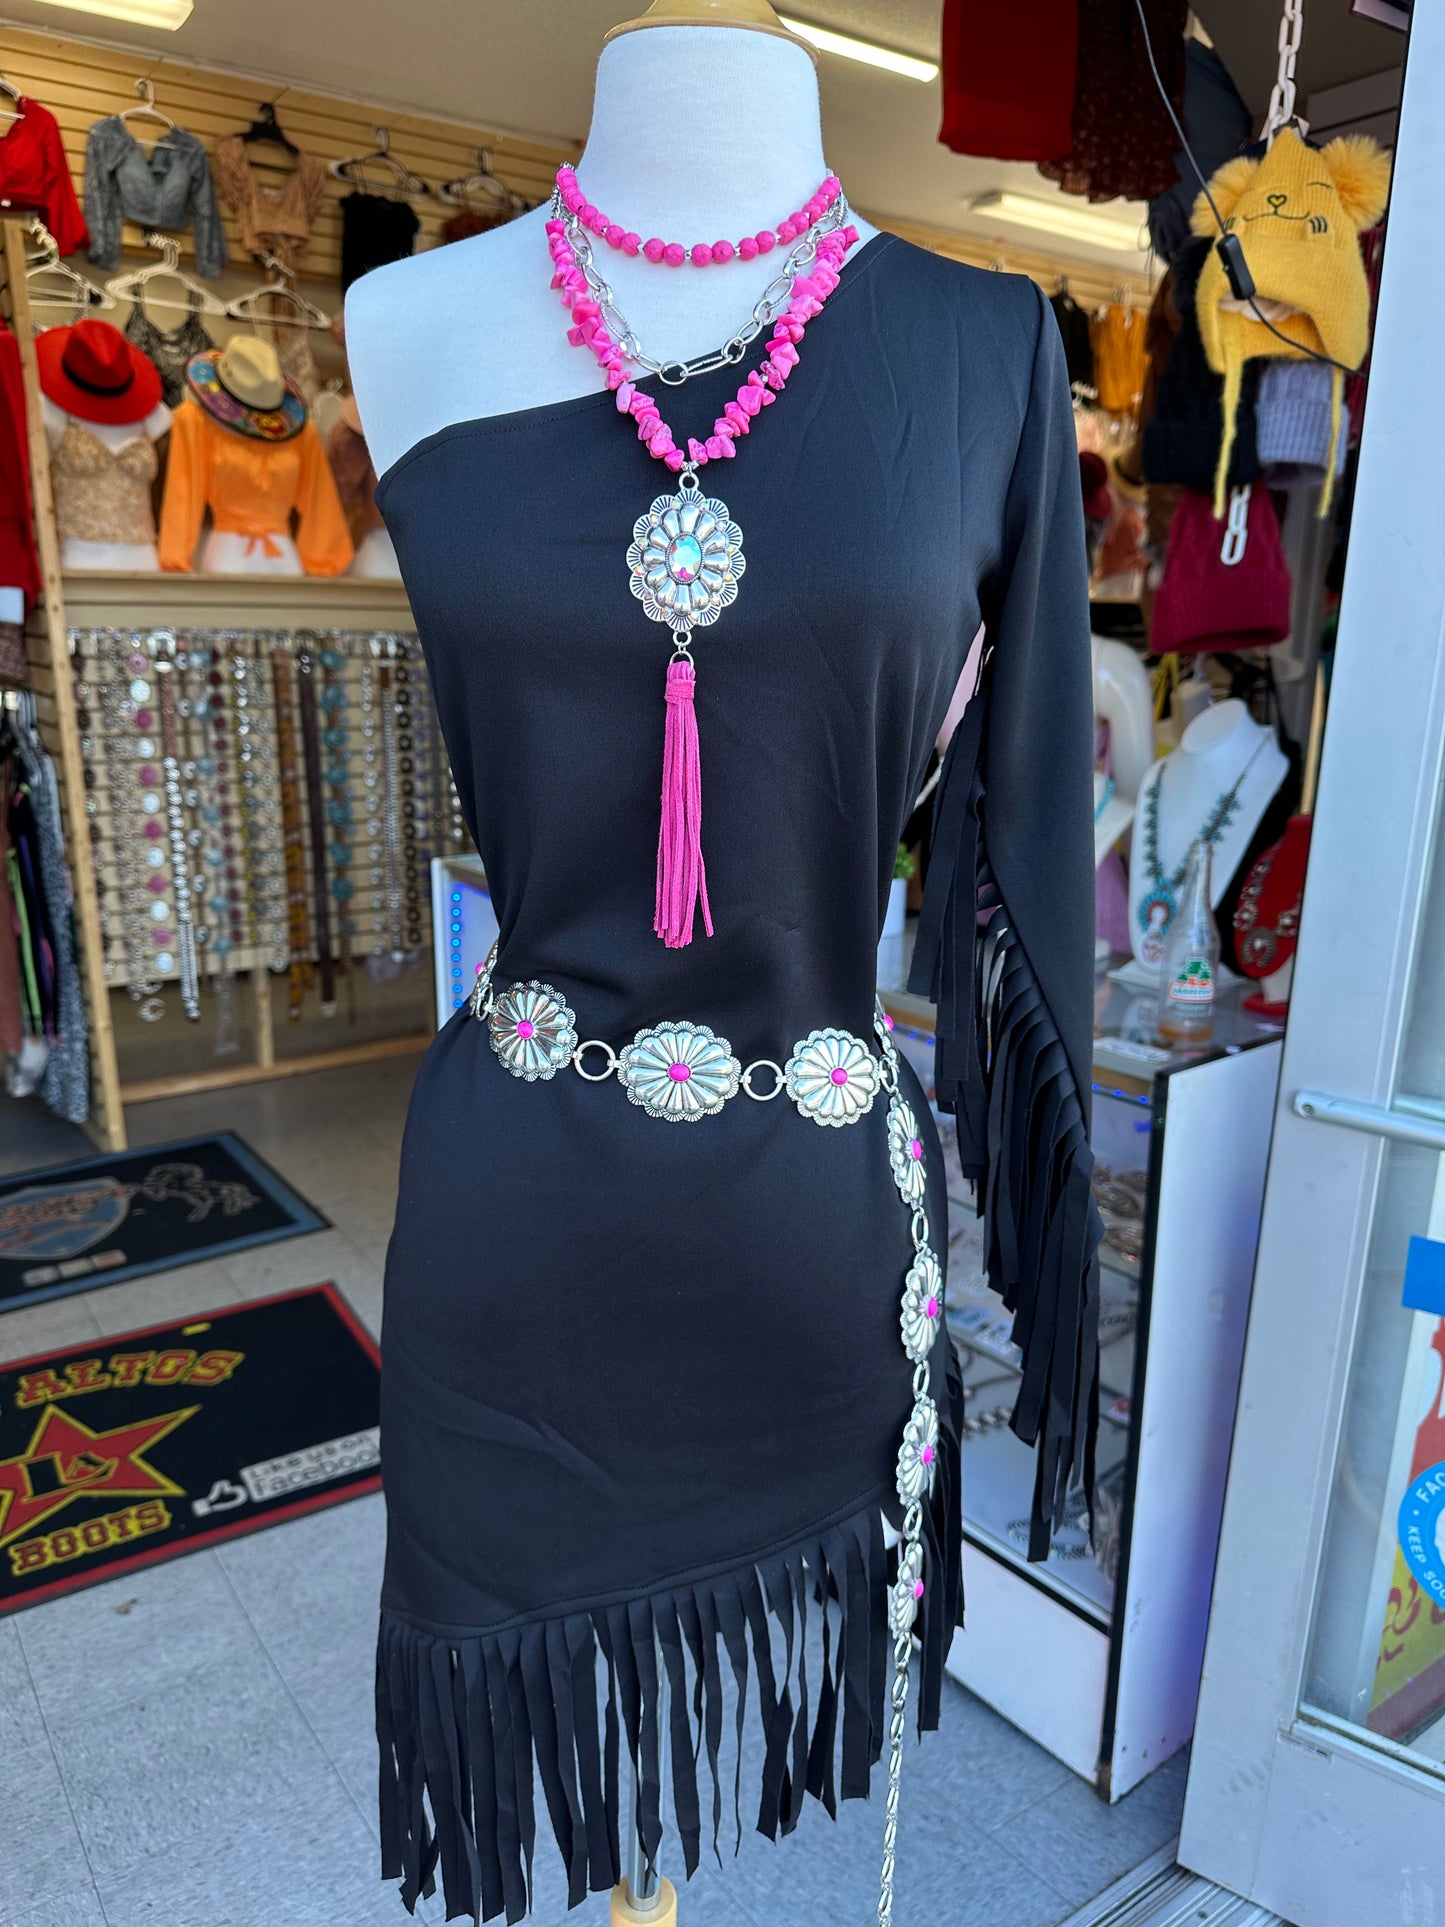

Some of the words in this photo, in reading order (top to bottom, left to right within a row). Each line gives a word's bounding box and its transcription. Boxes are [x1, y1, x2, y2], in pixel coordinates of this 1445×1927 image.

[16, 1349, 246, 1409] ALTOS
[253, 1444, 380, 1497] Faceboo
[9, 1499, 172, 1576] BOOTS
[1407, 1525, 1427, 1563] KEEP
